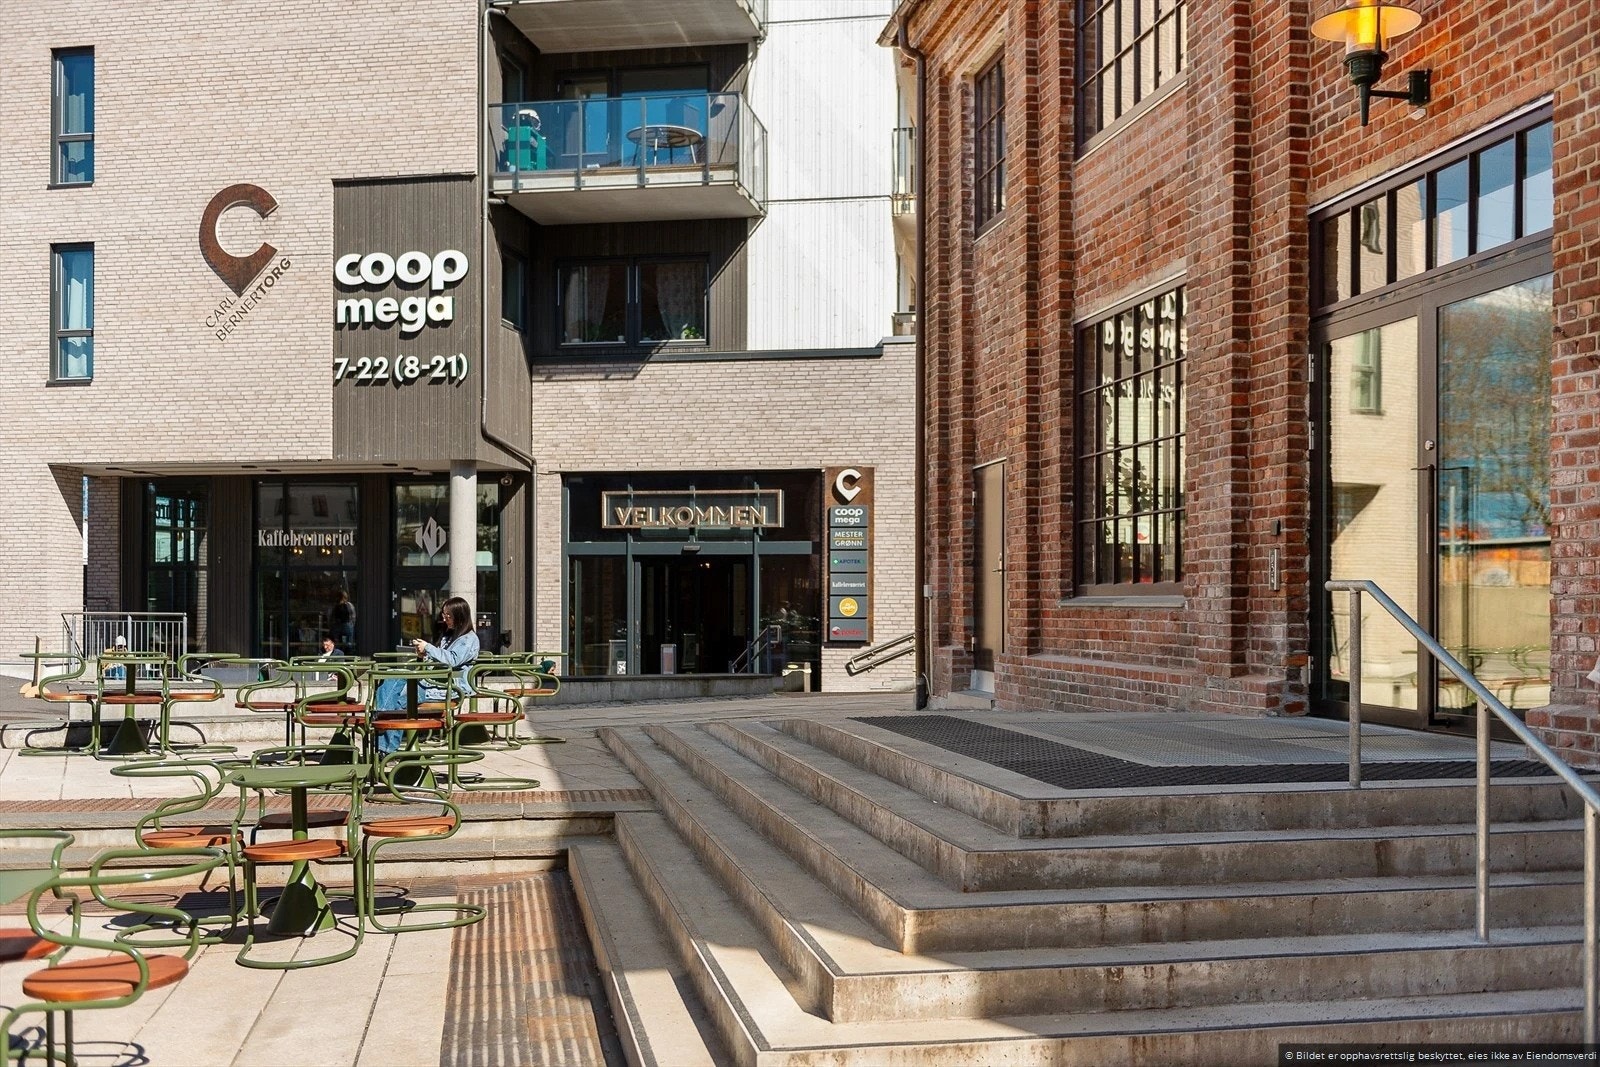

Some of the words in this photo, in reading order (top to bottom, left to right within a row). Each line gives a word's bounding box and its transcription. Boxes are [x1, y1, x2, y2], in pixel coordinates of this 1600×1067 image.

[335, 249, 469, 291] coop
[205, 296, 236, 329] CARL
[336, 295, 454, 333] mega
[334, 357, 389, 380] 7-22
[394, 352, 469, 382] (8-21)
[614, 505, 768, 527] VELKOMMEN
[834, 508, 863, 517] coop
[834, 517, 860, 525] mega
[258, 529, 354, 547] Kaffebrenneriet
